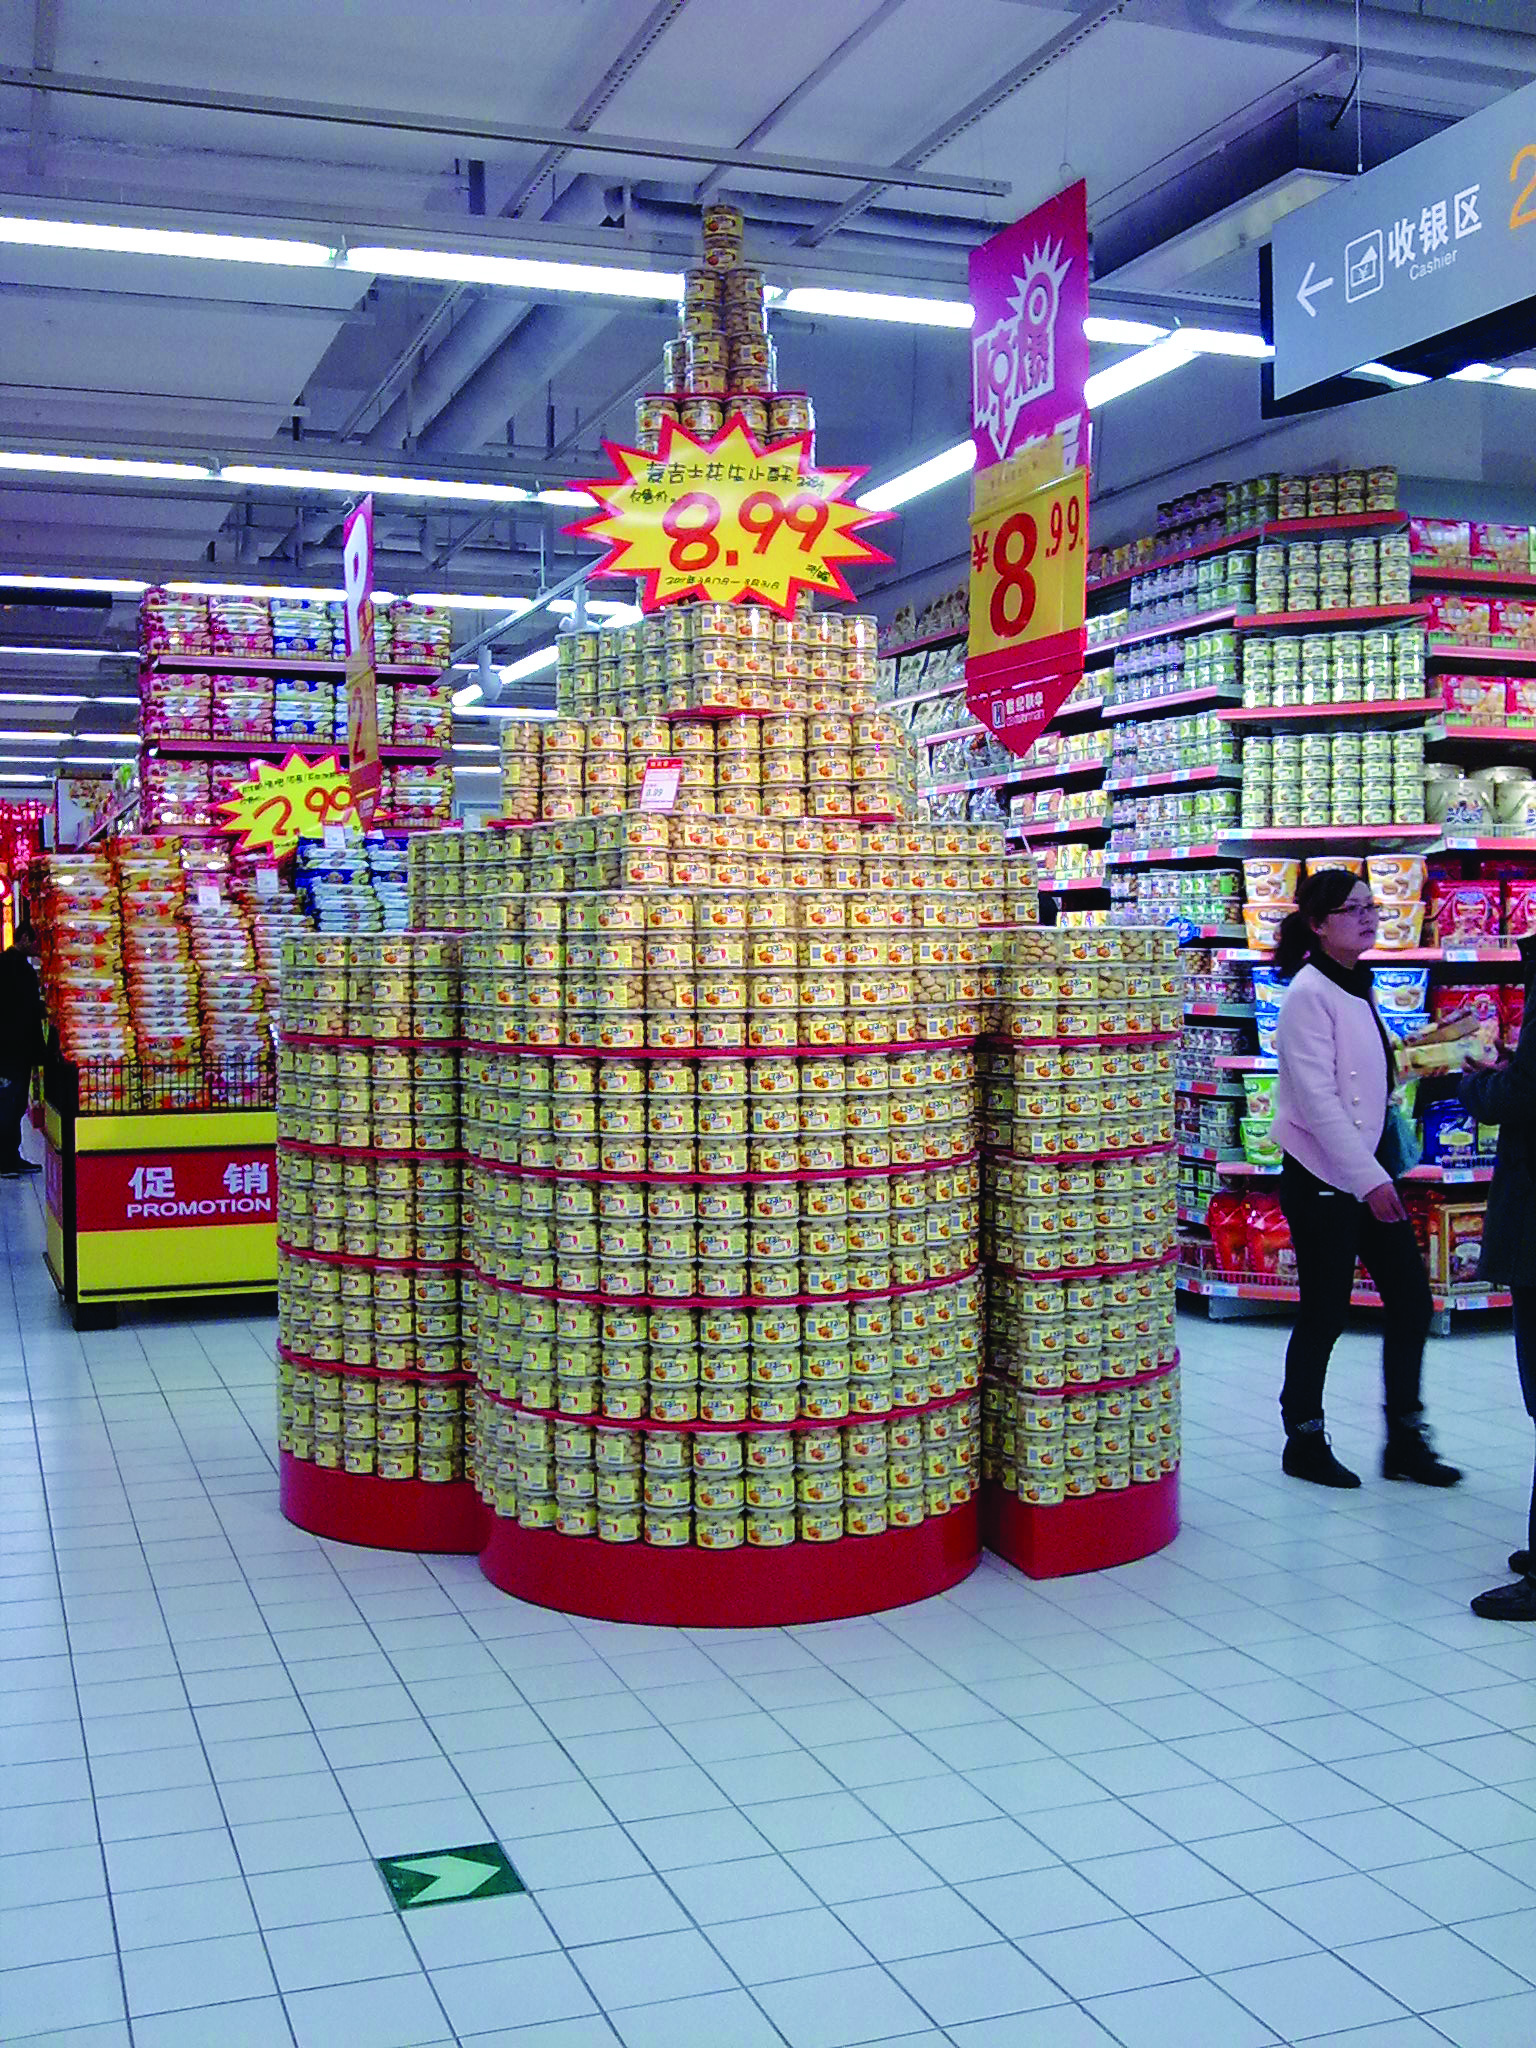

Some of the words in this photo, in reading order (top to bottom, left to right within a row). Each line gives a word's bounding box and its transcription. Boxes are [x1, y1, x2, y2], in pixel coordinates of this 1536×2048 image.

[1388, 184, 1482, 268] 收银区
[1409, 249, 1458, 281] Cashier
[662, 490, 829, 571] 8.99
[253, 785, 354, 836] 2.99
[128, 1161, 269, 1200] 促销
[126, 1197, 271, 1218] PROMOTION
